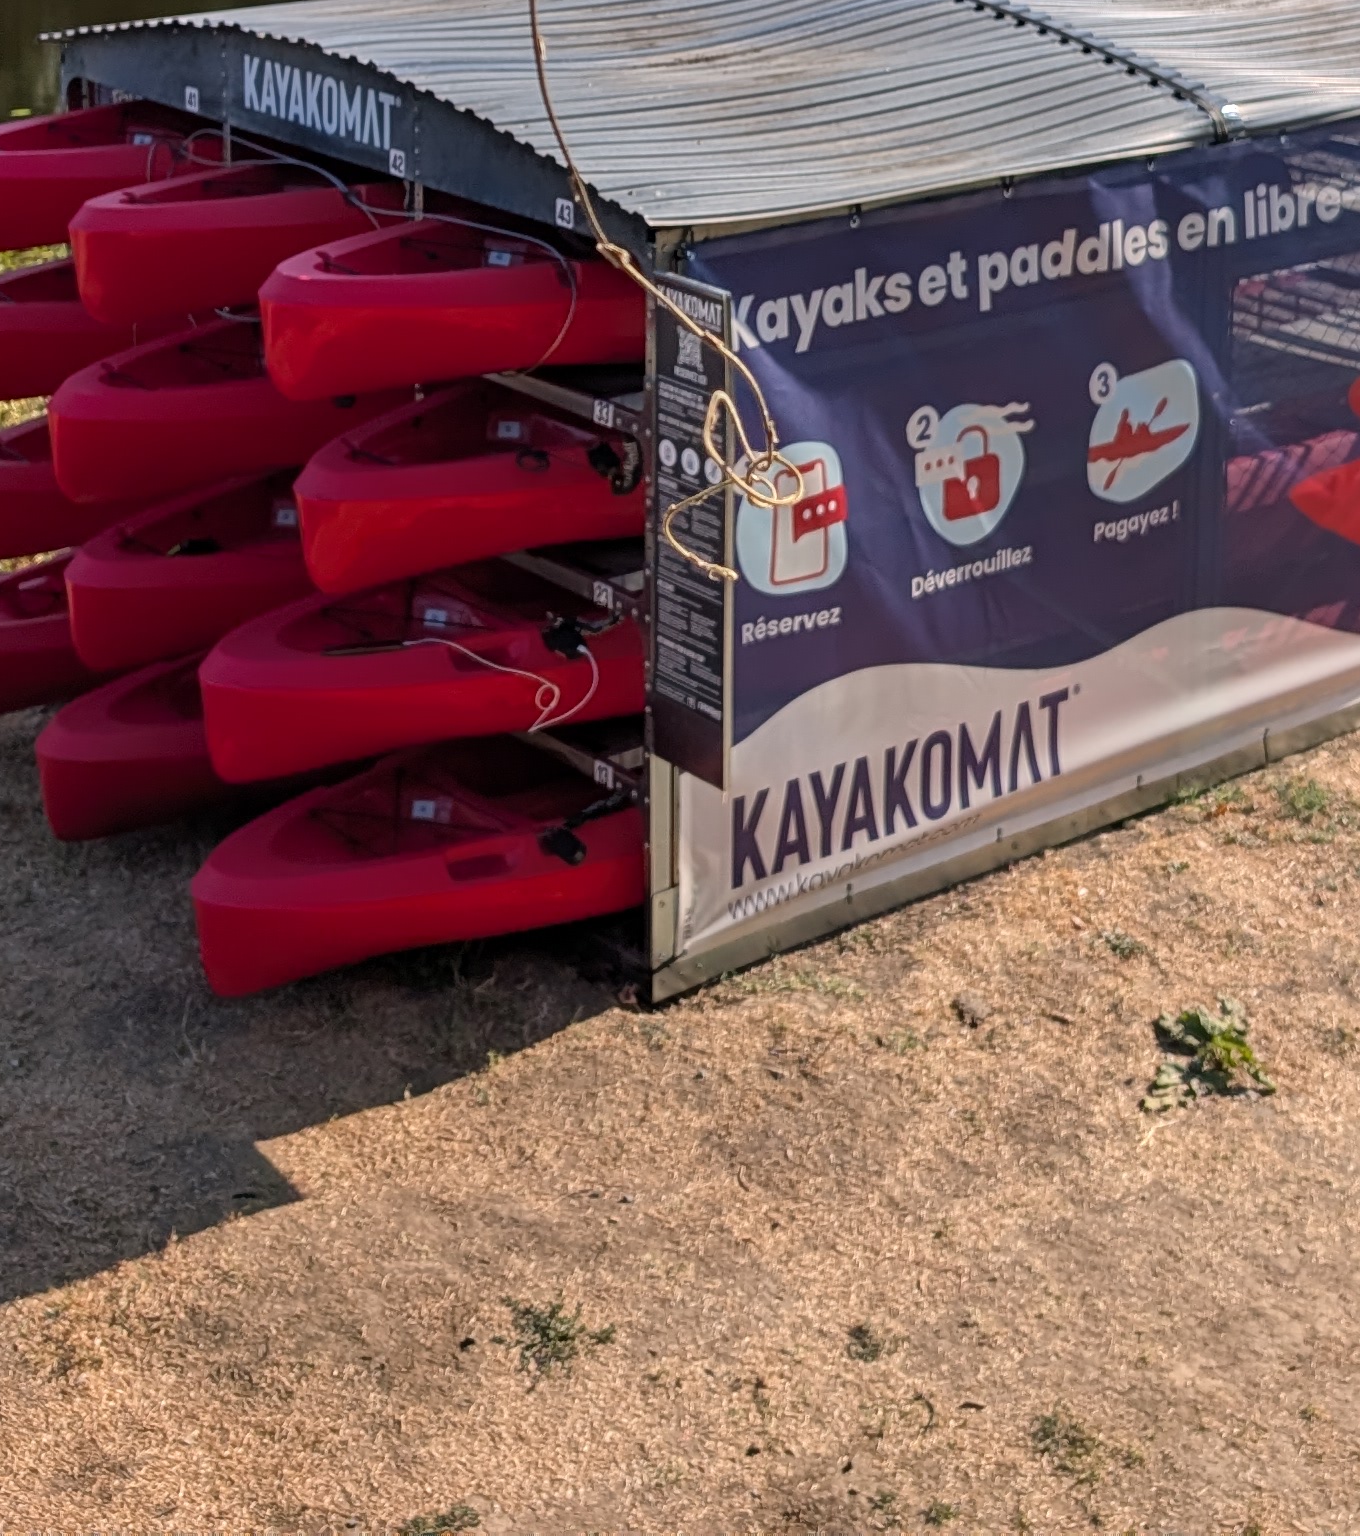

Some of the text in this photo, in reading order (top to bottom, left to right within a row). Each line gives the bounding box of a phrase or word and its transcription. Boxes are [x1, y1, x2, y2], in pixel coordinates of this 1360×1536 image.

[731, 267, 912, 354] Kayaks
[918, 250, 970, 307] et
[977, 220, 1169, 312] paddles
[1176, 204, 1237, 252] en
[1096, 371, 1111, 398] 3
[916, 414, 932, 443] 2
[1093, 507, 1170, 542] Pagayez
[911, 545, 1033, 599] Déverrouillez
[741, 606, 842, 646] Réservez
